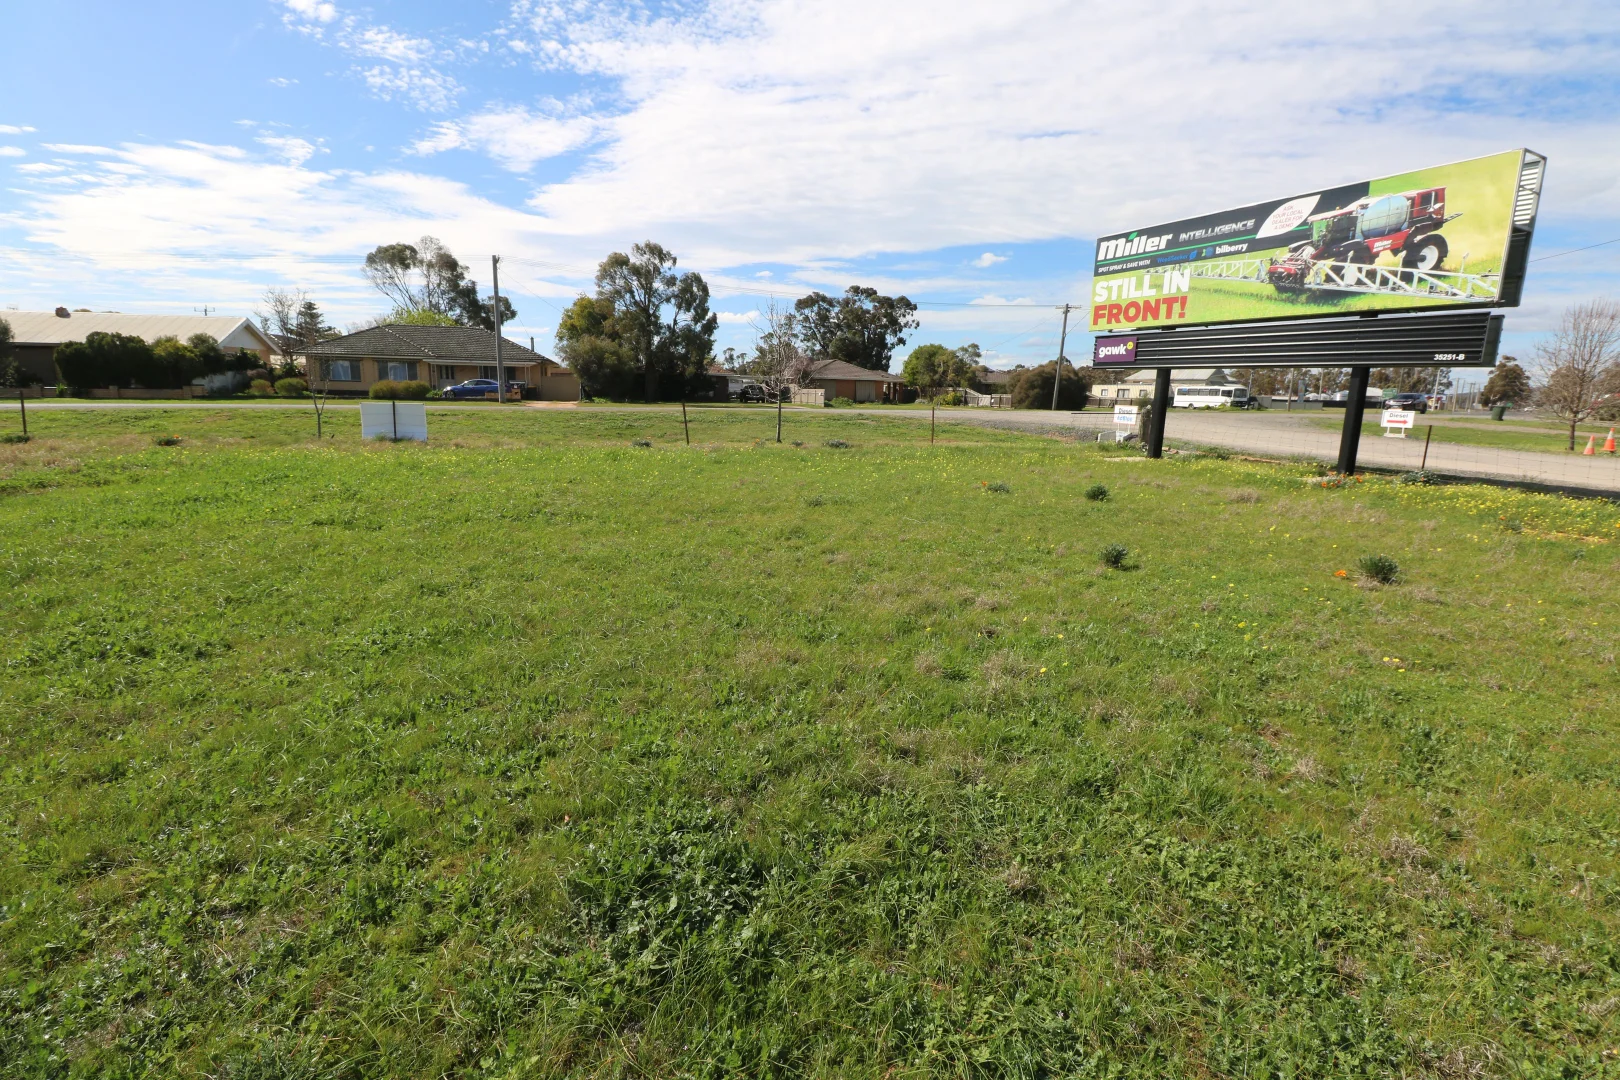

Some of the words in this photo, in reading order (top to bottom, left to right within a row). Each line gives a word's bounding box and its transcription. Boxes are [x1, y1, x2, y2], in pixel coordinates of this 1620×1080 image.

[1272, 216, 1291, 225] DEALER
[1179, 219, 1256, 242] INTELLIGENCE
[1215, 243, 1249, 254] bilberry
[1127, 261, 1138, 269] SAVE
[1138, 259, 1151, 267] WITH
[1094, 272, 1157, 302] STILL
[1163, 268, 1191, 295] IN
[1092, 296, 1188, 326] FRONT!
[1098, 343, 1126, 358] gawk
[1434, 353, 1465, 361] 35251-B
